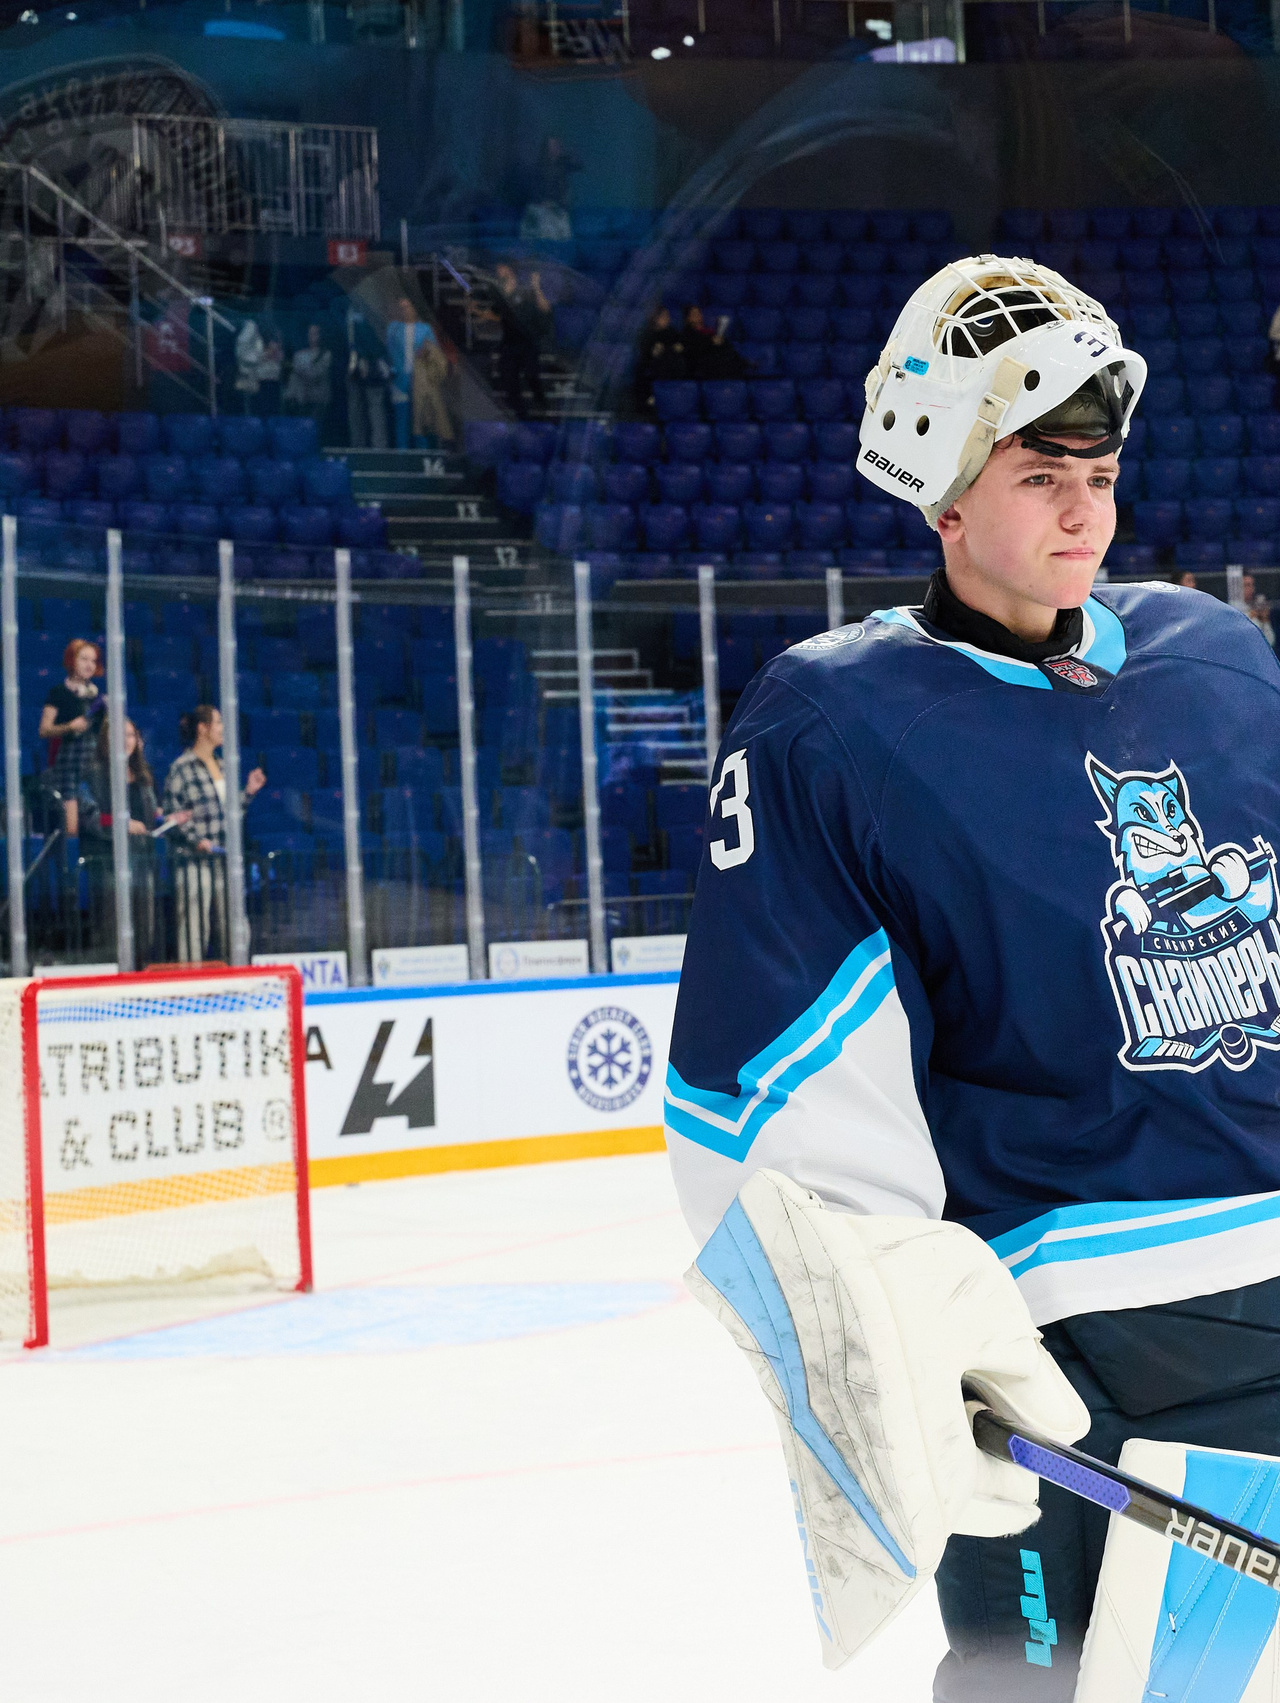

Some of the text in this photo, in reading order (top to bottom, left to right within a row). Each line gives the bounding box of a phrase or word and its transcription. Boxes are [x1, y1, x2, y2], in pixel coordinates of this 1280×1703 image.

[863, 449, 925, 493] BAUER
[709, 748, 755, 871] 3
[1154, 920, 1238, 951] СИБИРСКИЕ
[38, 1025, 333, 1098] TRIBUTIKA
[109, 1099, 245, 1162] CLUB
